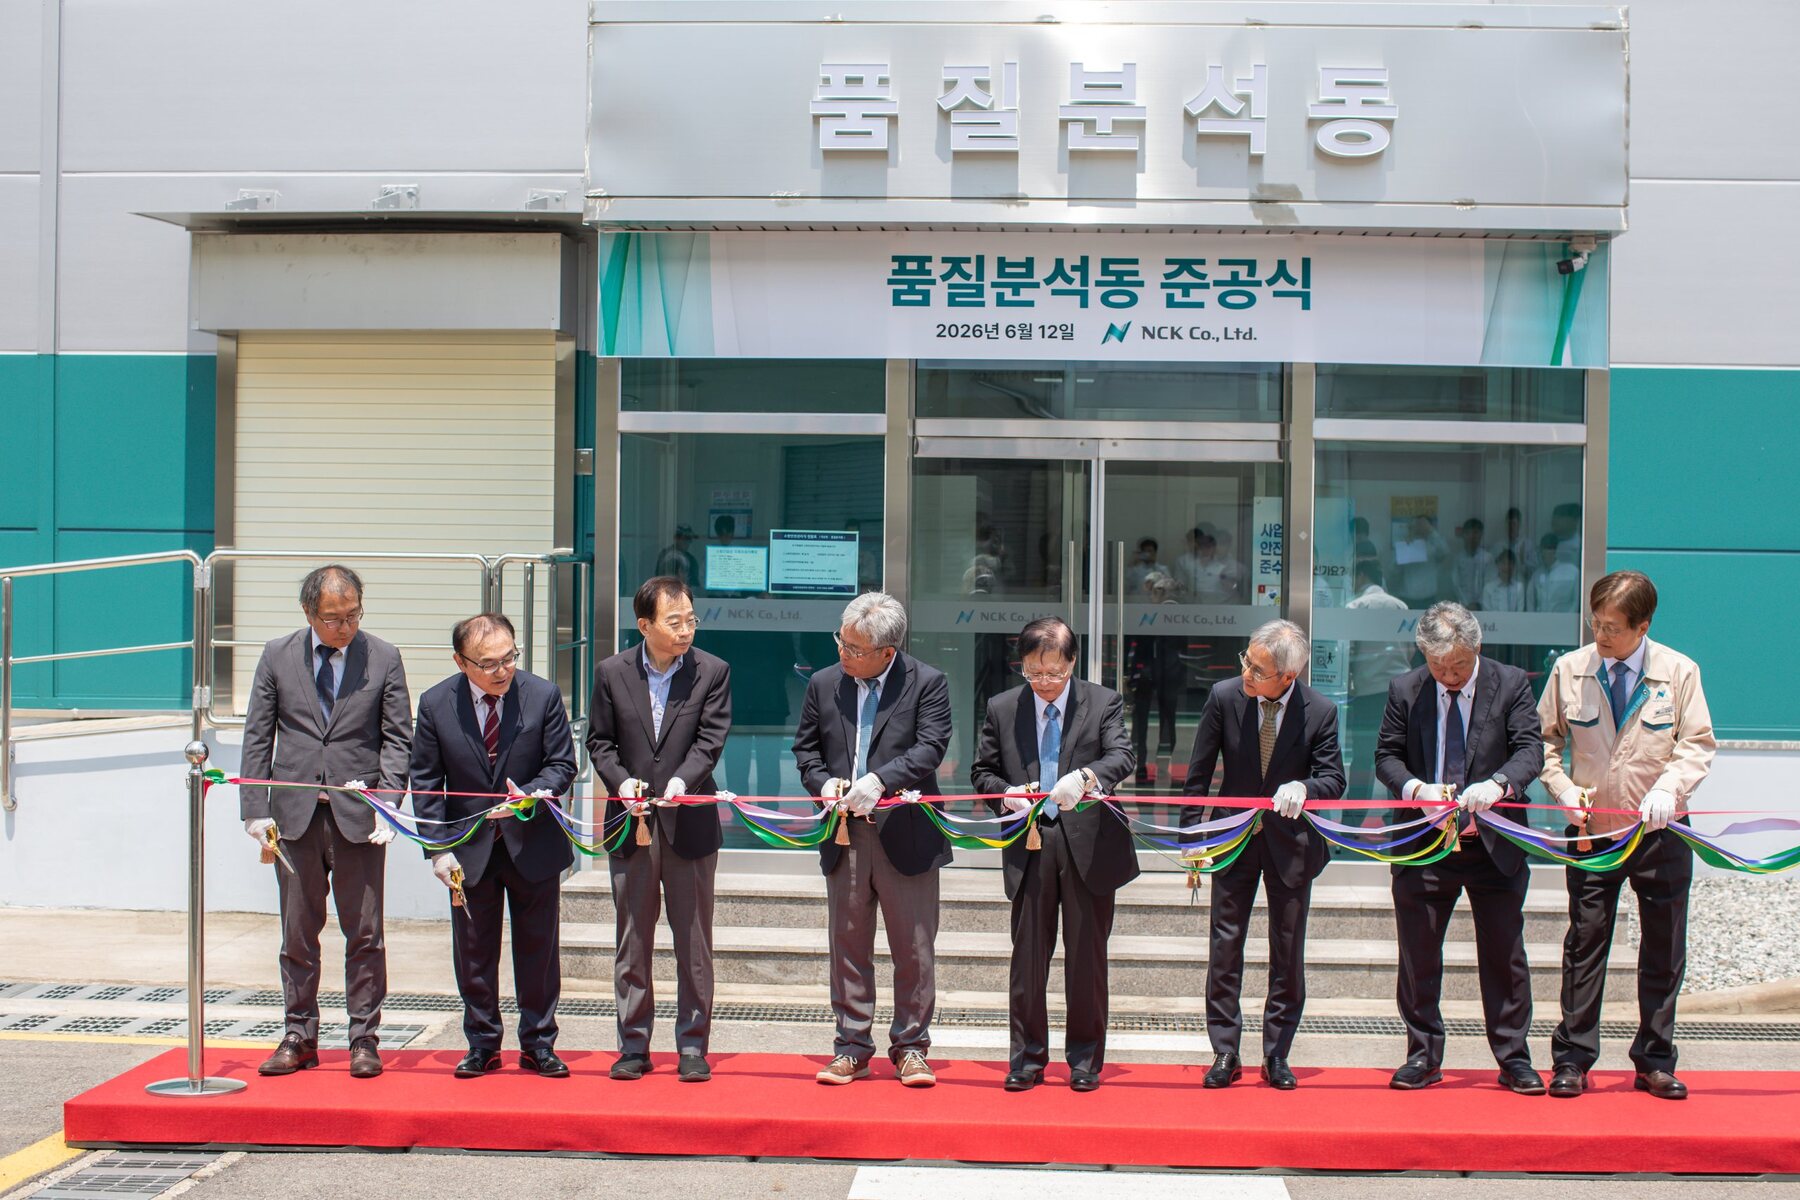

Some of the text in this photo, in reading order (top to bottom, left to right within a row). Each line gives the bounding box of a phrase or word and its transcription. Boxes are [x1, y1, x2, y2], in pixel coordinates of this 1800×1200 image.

[809, 62, 1399, 158] 품질분석동
[887, 254, 1311, 311] 품질분석동 준공식
[936, 322, 1074, 341] 2026년 6월 12일
[1141, 326, 1258, 343] NCK Co., Ltd.
[727, 608, 754, 620] NCK
[980, 611, 1007, 623] NCK
[1163, 613, 1190, 624] NCK
